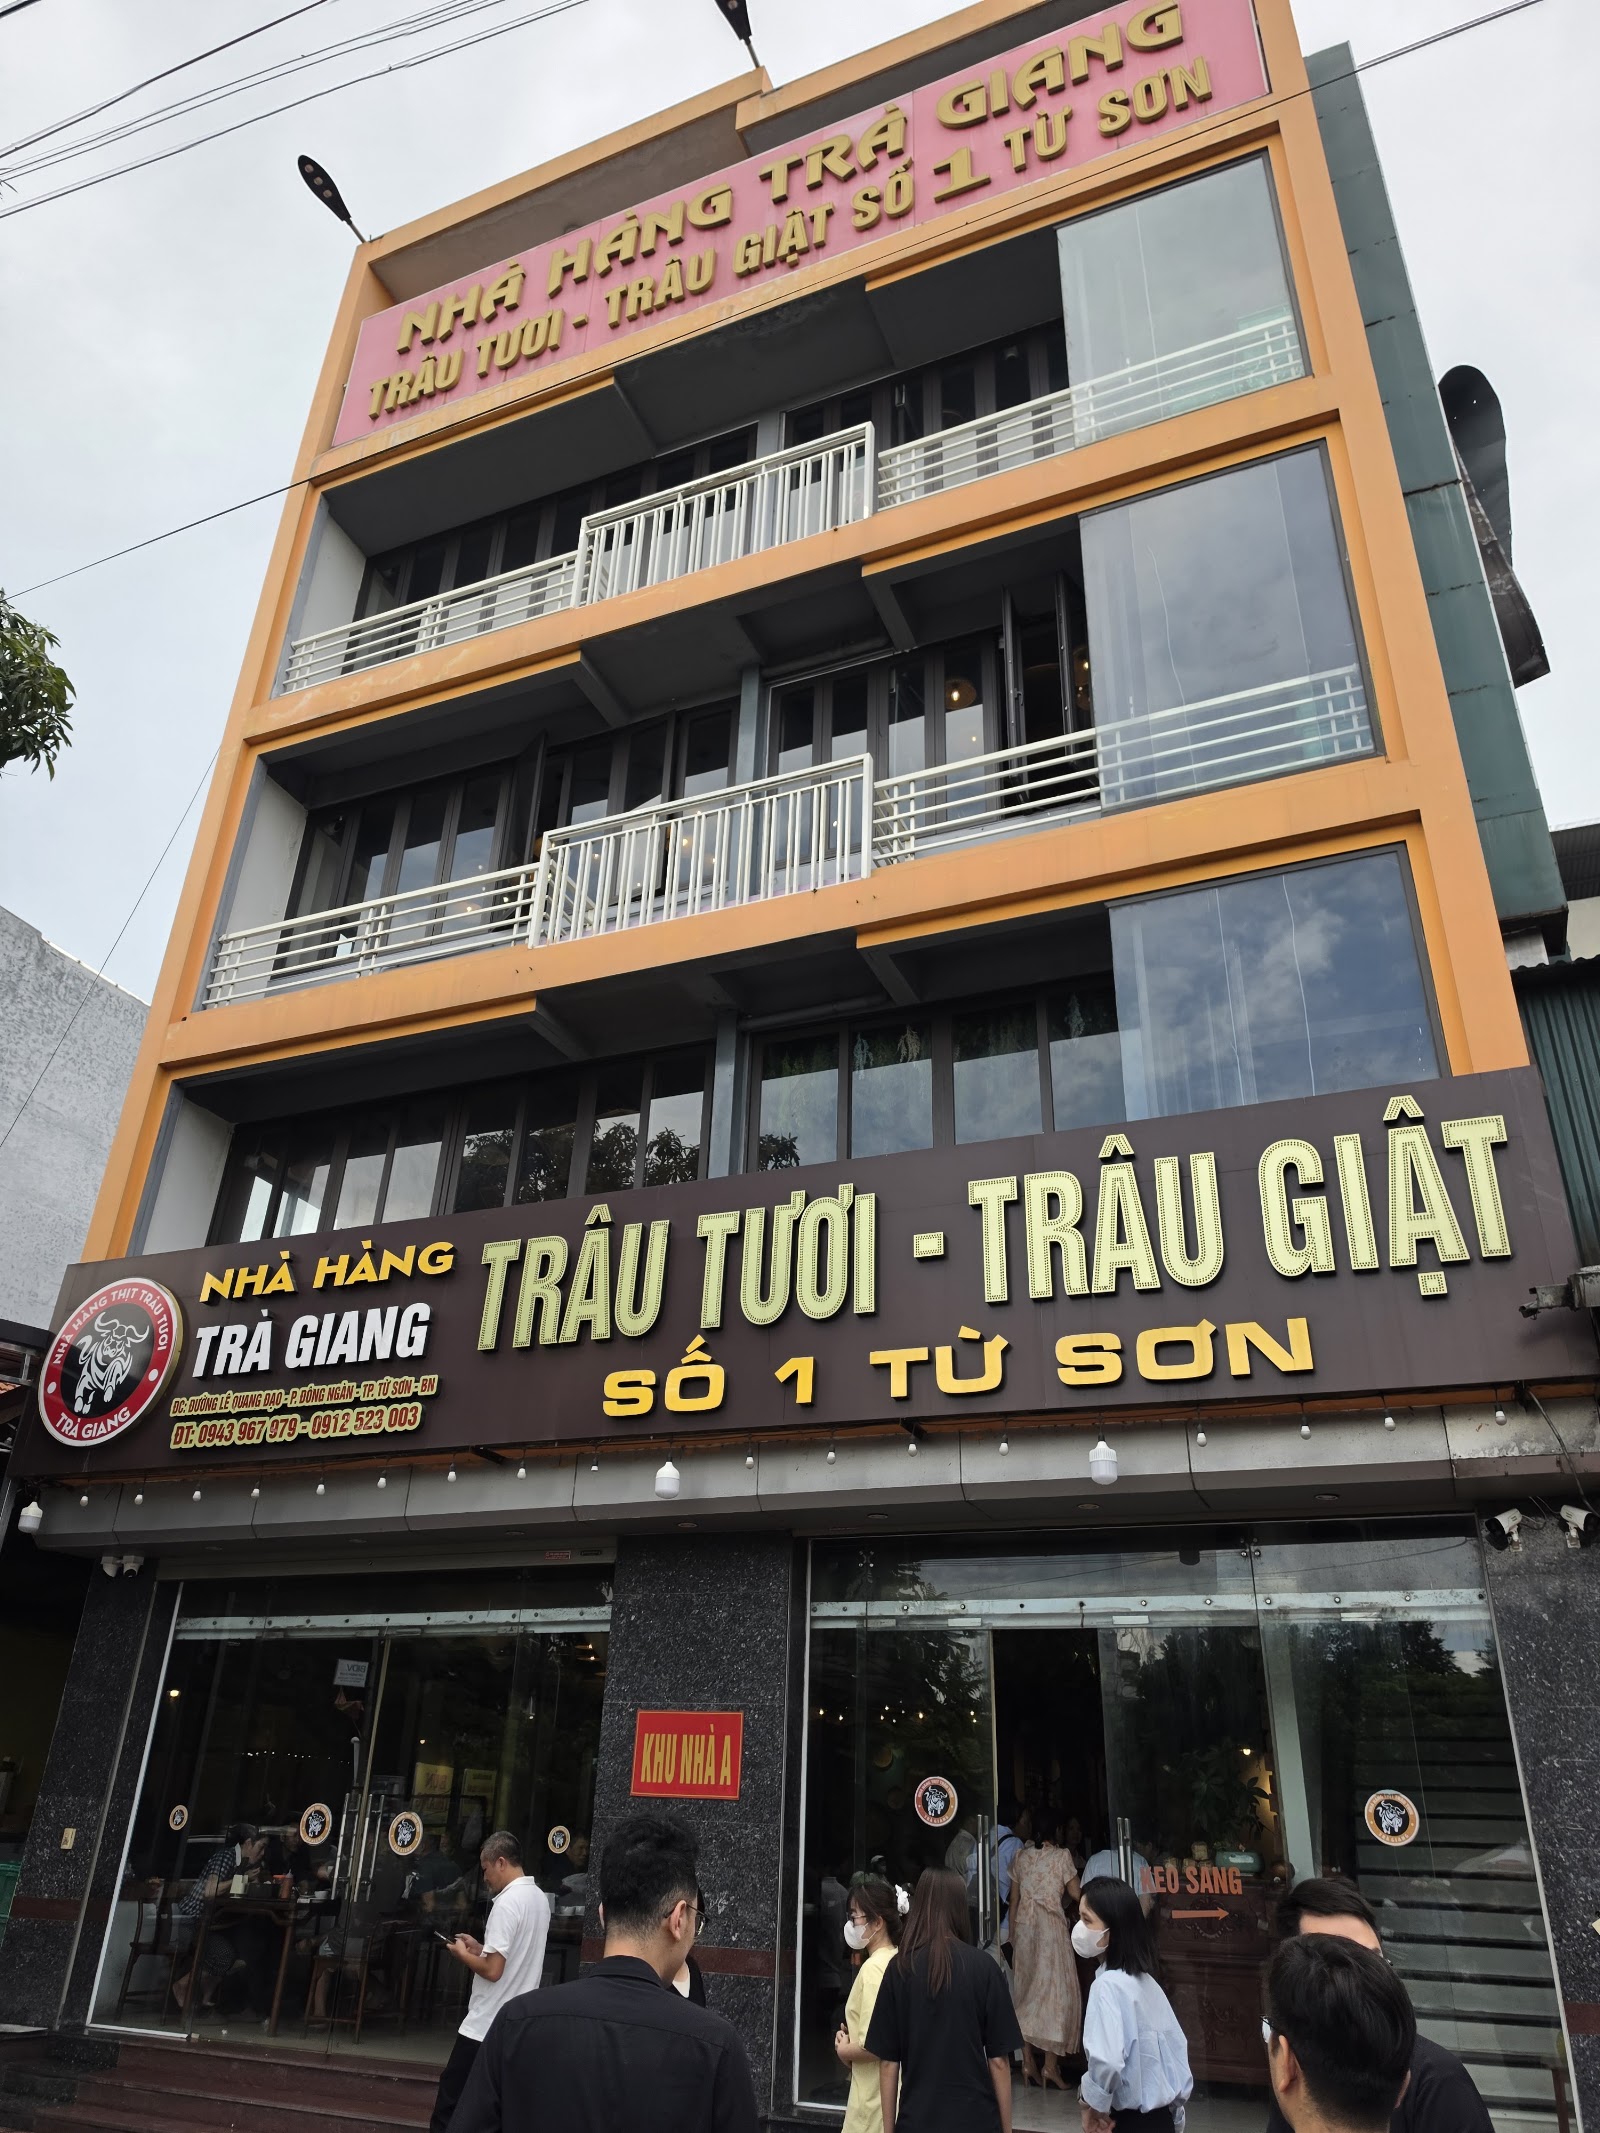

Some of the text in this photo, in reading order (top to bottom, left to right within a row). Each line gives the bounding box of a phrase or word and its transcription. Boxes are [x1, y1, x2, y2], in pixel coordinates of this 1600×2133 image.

[398, 1, 1183, 354] NHÀ HÀNG TRÀ GIANG
[369, 347, 465, 420] TRÂU
[476, 307, 565, 379] TƯƠI
[606, 248, 717, 330] TRÂU
[732, 203, 834, 278] GIẬT
[851, 157, 915, 231] SỐ
[934, 146, 991, 203] 1
[1003, 105, 1073, 173] TỪ
[1097, 55, 1213, 138] SƠN
[476, 1203, 671, 1351] TRÂU
[696, 1183, 876, 1329] TƯƠI
[967, 1133, 1225, 1303] TRÂU
[1258, 1094, 1512, 1297] GIẬT
[199, 1239, 454, 1303] NHÀ HÀNG
[53, 1332, 74, 1365] NHÀ
[72, 1296, 108, 1331] HÀNG
[111, 1287, 138, 1302] THỊT
[140, 1289, 164, 1316] TRÂU
[192, 1302, 431, 1378] TRÀ GIANG
[172, 1400, 187, 1414] ĐC:
[188, 1394, 218, 1413] ĐƯỜNG
[219, 1393, 231, 1410] LÊ
[231, 1393, 262, 1410] QUANG
[263, 1391, 283, 1411] ĐẠO
[290, 1390, 297, 1404] P.
[326, 1383, 354, 1401] NGÀN
[362, 1383, 374, 1398] TP.
[377, 1378, 391, 1397] TỪ
[391, 1378, 412, 1396] SƠN
[421, 1377, 436, 1392] BN
[602, 1317, 1314, 1417] SỐ 1 TỪ SƠN
[55, 1406, 131, 1439] TRÀ GIANG
[173, 1425, 195, 1445] ĐT:
[198, 1422, 235, 1443] 0943
[237, 1420, 266, 1442] 967
[268, 1417, 298, 1439] 979
[311, 1412, 351, 1435] 0912
[353, 1409, 384, 1431] 523
[387, 1405, 419, 1428] 003
[641, 1723, 731, 1785] KHU NHÀ A
[1185, 1866, 1243, 1895] SANG
